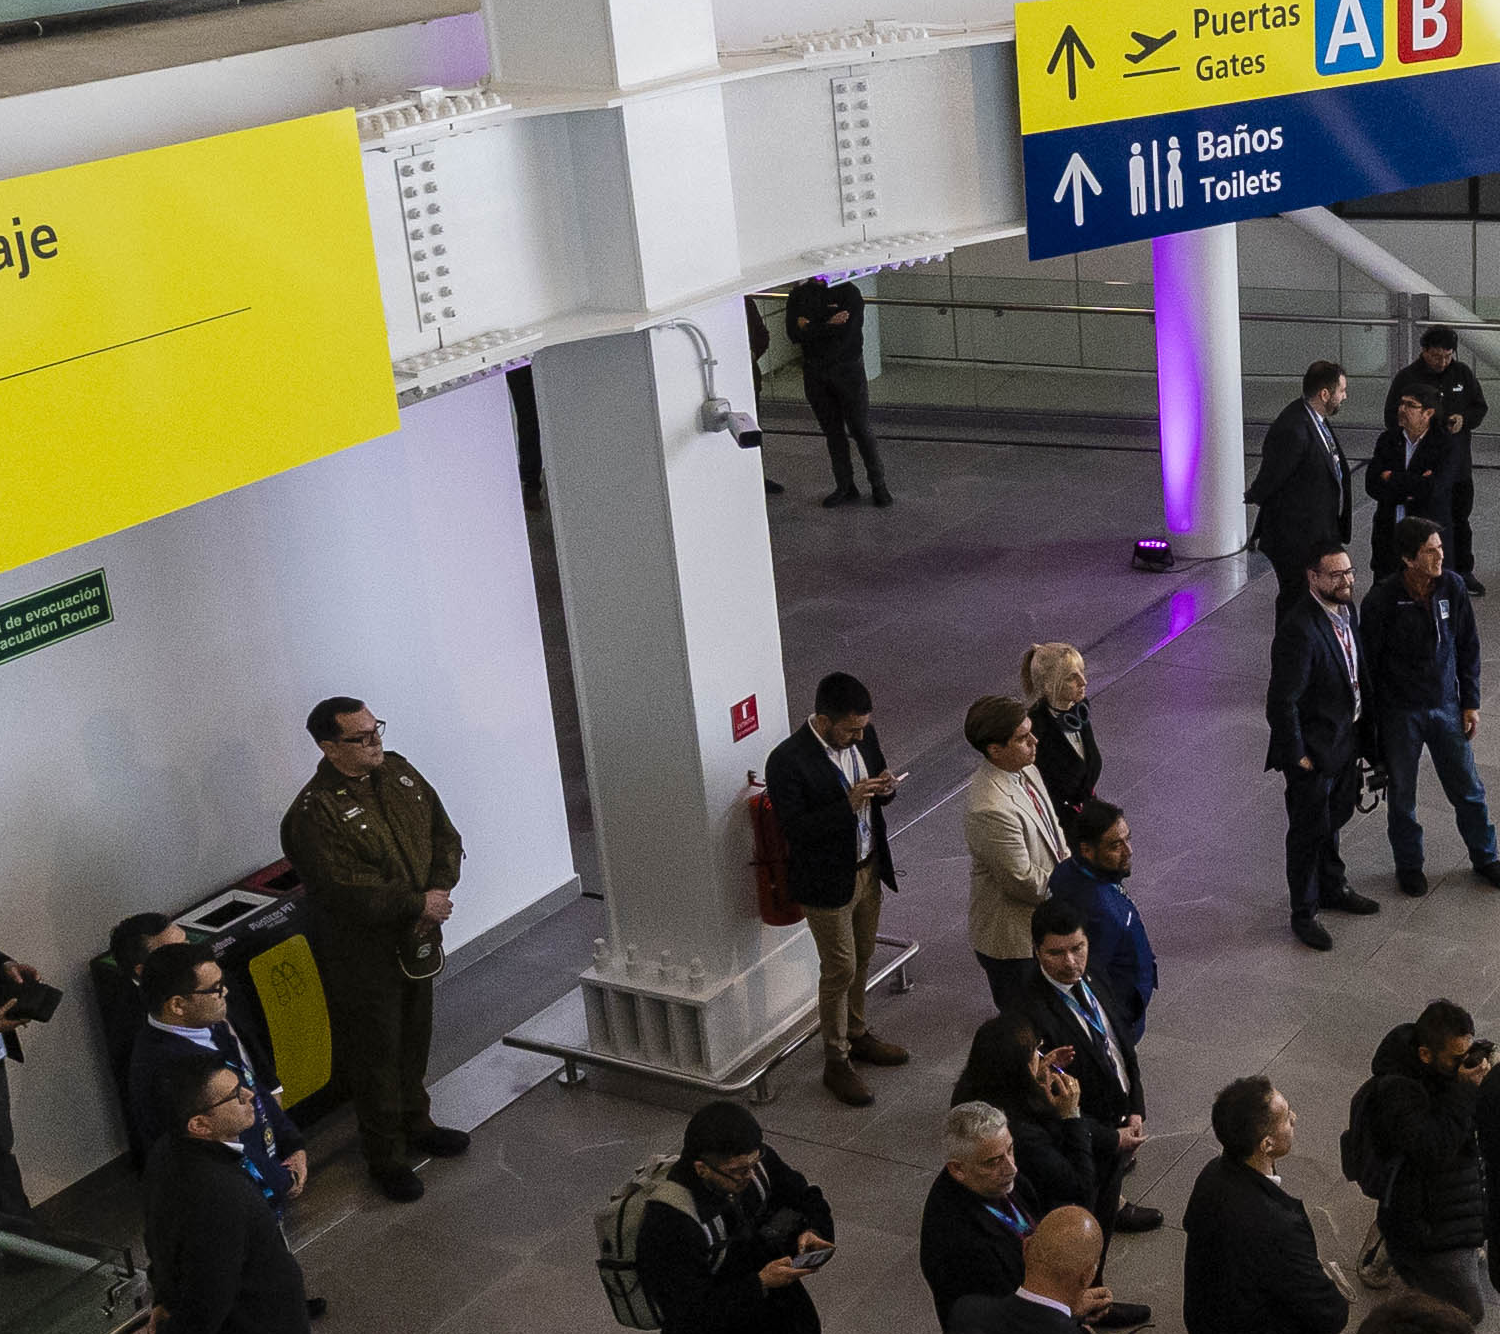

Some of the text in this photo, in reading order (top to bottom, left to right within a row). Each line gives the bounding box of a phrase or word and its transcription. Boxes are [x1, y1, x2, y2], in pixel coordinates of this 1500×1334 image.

[1194, 3, 1300, 39] Puertas
[1196, 53, 1265, 82] Gates
[1197, 122, 1284, 162] Baños
[1199, 168, 1282, 203] Toilets
[5, 616, 22, 630] de
[25, 586, 101, 623] evacuación
[60, 604, 100, 627] Route
